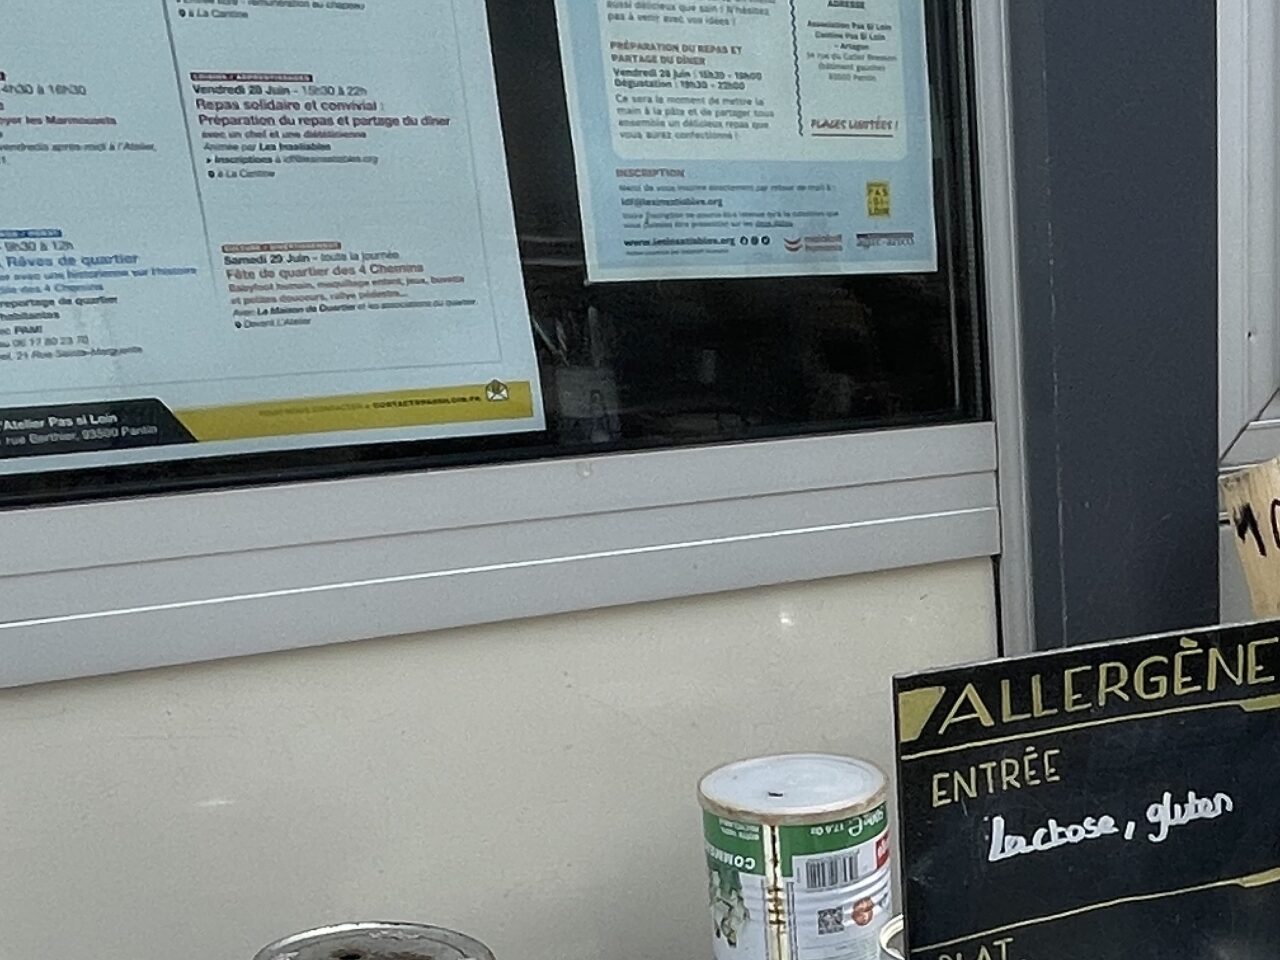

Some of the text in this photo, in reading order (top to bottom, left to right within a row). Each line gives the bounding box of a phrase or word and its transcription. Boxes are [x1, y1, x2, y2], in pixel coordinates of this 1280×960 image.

[609, 39, 742, 55] PRÉPARATION DU REPAS ET
[611, 54, 658, 64] PARTAGE
[659, 55, 674, 64] DU
[613, 67, 657, 78] Vendredi
[37, 83, 45, 95] à
[614, 78, 672, 89] Dégustation
[192, 85, 246, 96] Vendredi
[265, 85, 290, 96] Juin
[338, 85, 346, 95] à
[347, 86, 368, 96] 22h
[196, 98, 377, 112] Repas solidaire et convivial
[198, 113, 451, 128] Préparation du repas et partage du dîner
[810, 114, 893, 130] PLACES LIMITÉES
[201, 130, 226, 139] avec
[228, 130, 242, 139] un
[269, 130, 280, 139] et
[259, 142, 277, 151] Les
[214, 155, 273, 165] Inscriptions
[616, 168, 685, 179] INSCRIPTION
[40, 240, 48, 251] à
[6, 255, 139, 267] Rêves de quartier
[223, 254, 268, 266] Samedi
[270, 254, 283, 265] 29
[286, 253, 311, 264] Juin
[226, 263, 424, 281] Fête de quartier des 4 Chemins
[58, 297, 73, 306] de
[48, 416, 74, 427] Pas
[89, 413, 118, 425] Loin
[121, 425, 158, 437] Pantin
[931, 746, 1061, 809] ENTRÉE
[1146, 791, 1235, 843] gluten
